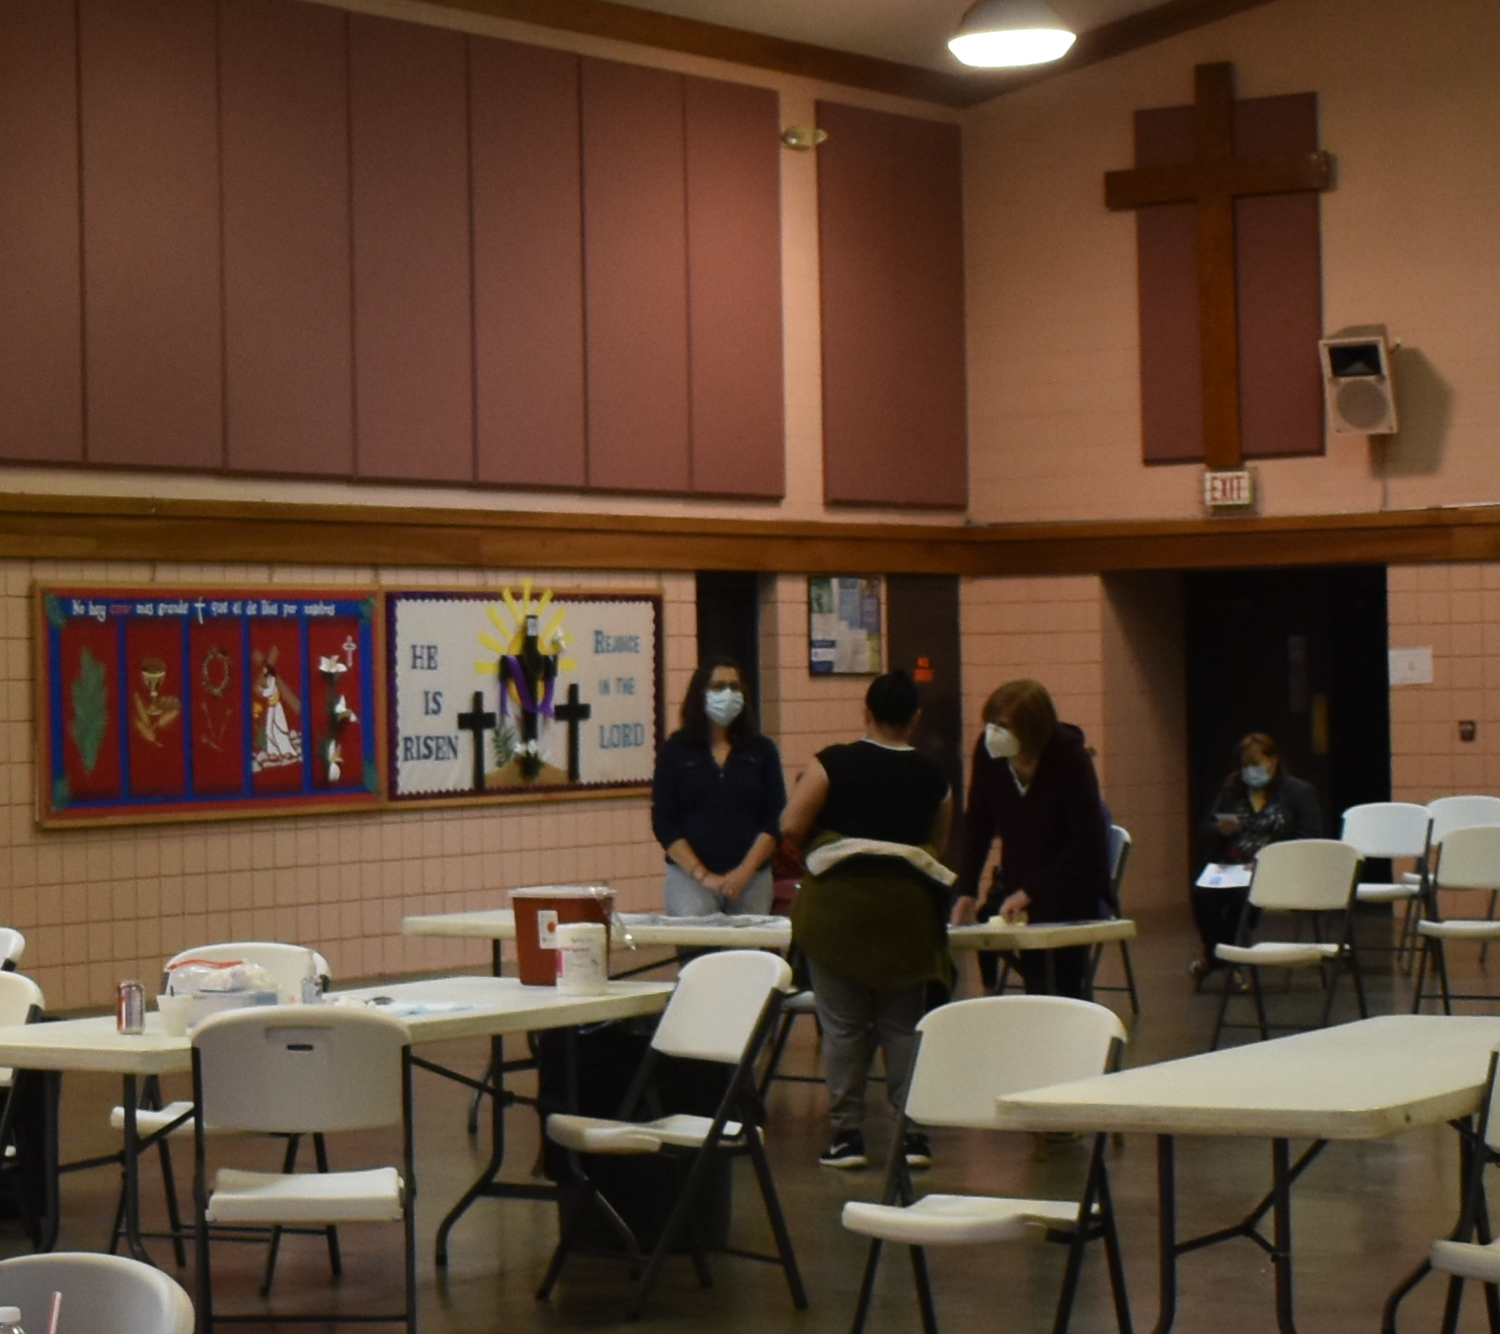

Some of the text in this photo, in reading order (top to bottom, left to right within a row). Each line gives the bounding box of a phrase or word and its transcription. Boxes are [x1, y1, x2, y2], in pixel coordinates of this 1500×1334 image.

[1211, 475, 1244, 501] EXIT
[72, 599, 85, 616] No
[88, 599, 106, 622] hay
[411, 644, 438, 670] HE
[616, 677, 635, 695] THE
[424, 690, 443, 716] IS
[403, 735, 459, 762] RISEN
[599, 724, 645, 750] LORD
